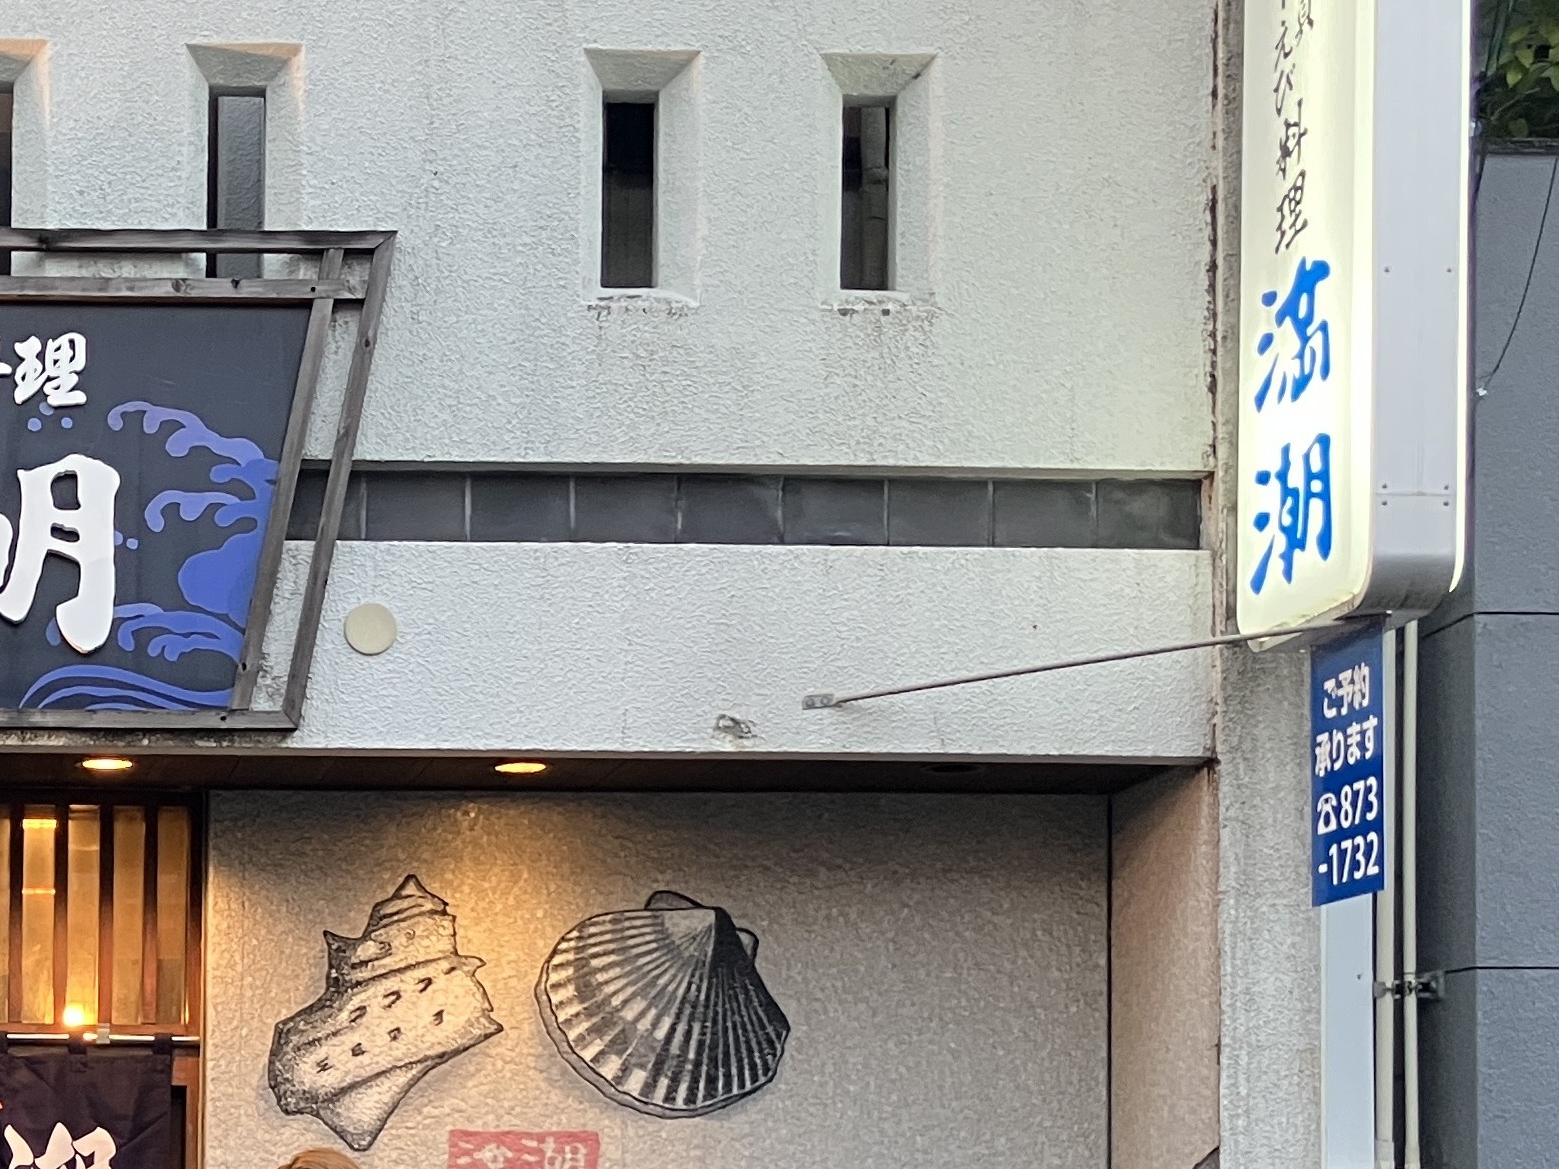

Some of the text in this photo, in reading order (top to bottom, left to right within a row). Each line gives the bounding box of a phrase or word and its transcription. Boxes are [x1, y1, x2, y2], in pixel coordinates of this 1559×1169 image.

[1322, 662, 1370, 719] ご予約
[1314, 714, 1379, 777] 承ります
[1318, 831, 1380, 886] -1732
